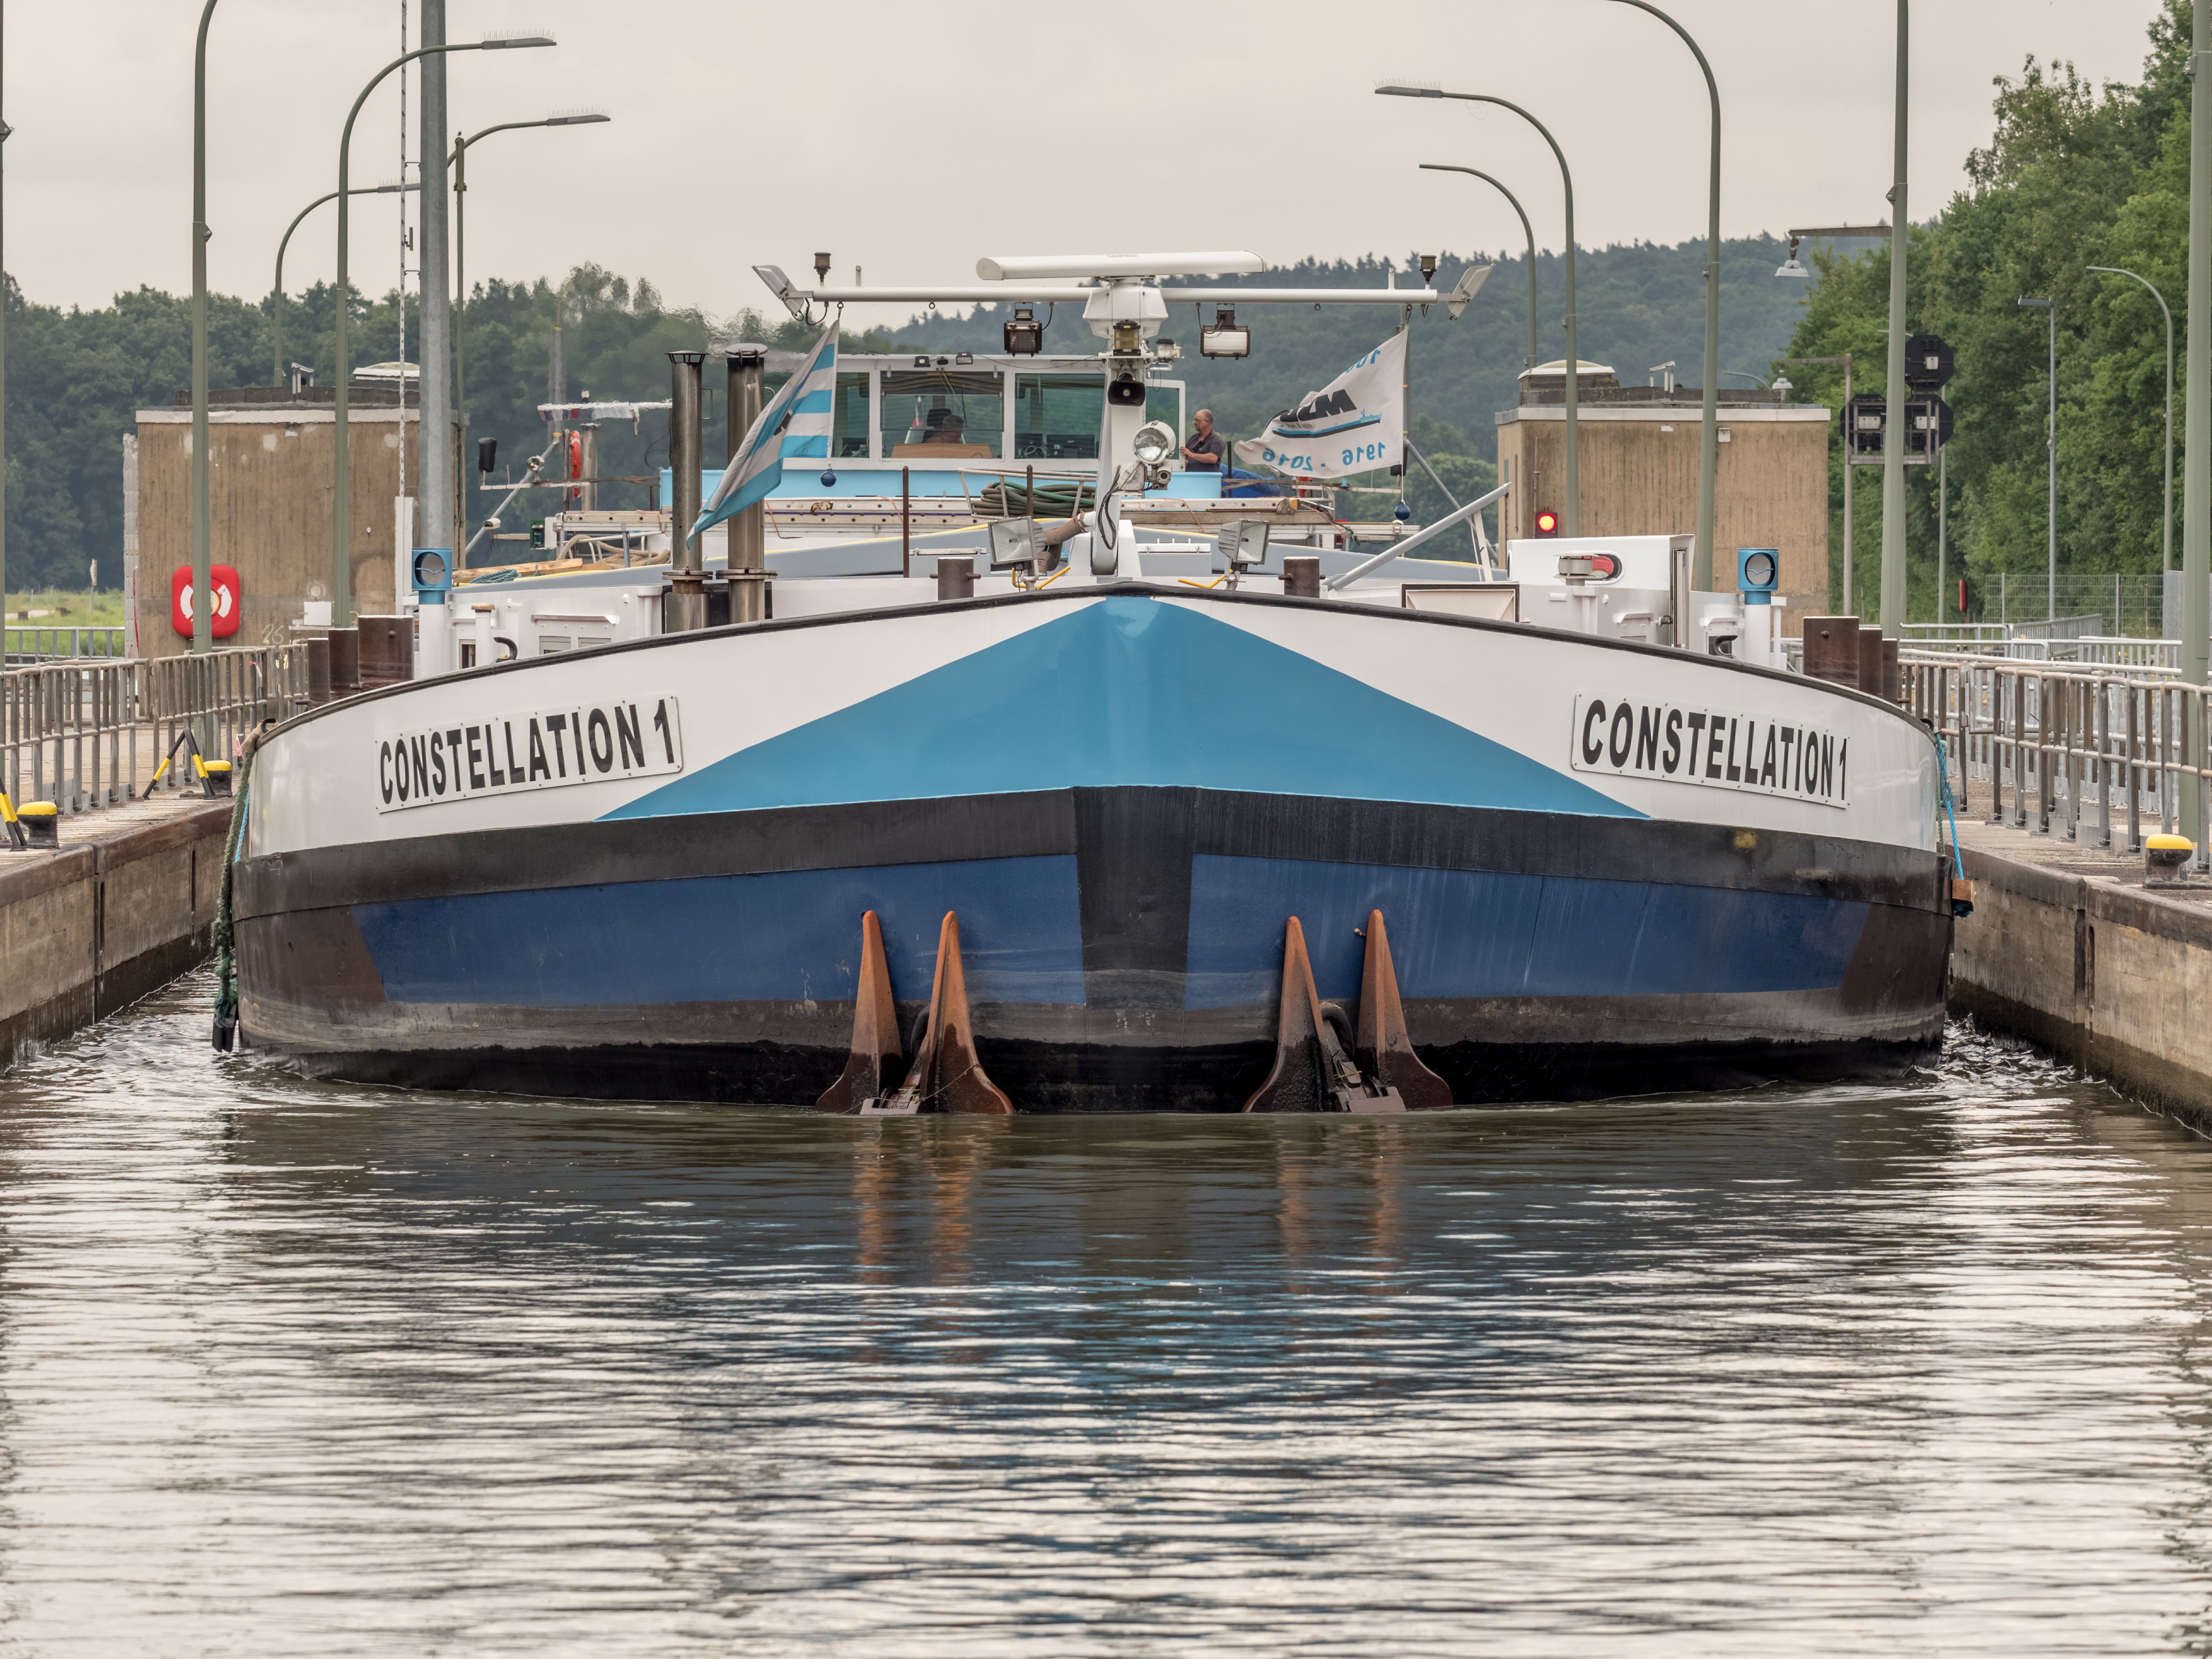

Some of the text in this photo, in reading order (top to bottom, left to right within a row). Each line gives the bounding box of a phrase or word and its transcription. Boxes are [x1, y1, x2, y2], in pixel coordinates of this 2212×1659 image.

[380, 699, 675, 805] CONSTELLATION 1
[1582, 699, 1846, 800] CONSTELLATION 1
